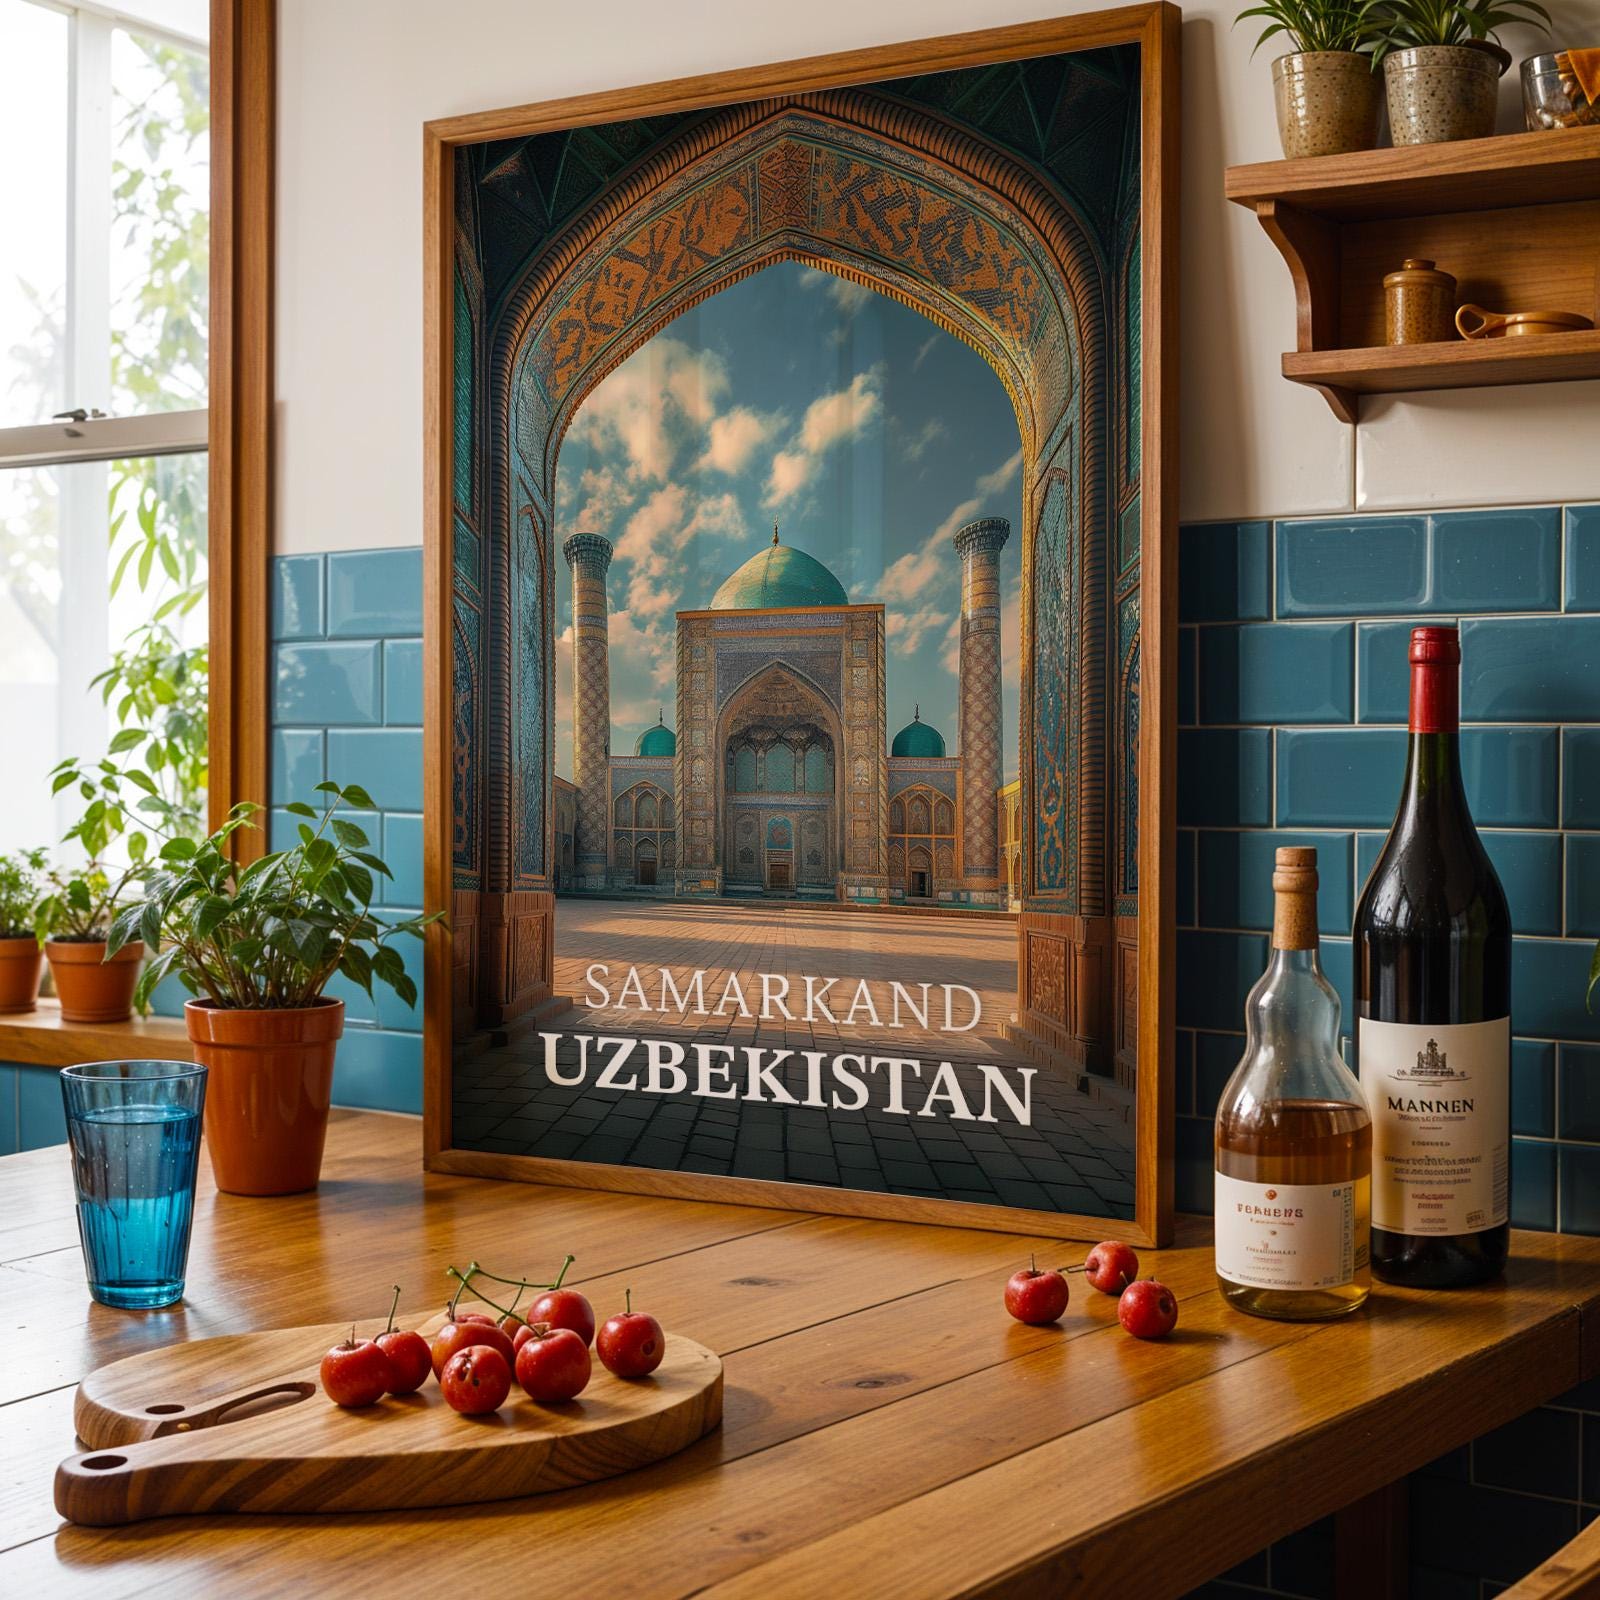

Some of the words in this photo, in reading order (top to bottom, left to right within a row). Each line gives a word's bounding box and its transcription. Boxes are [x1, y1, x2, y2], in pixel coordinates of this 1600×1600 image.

[585, 963, 982, 1032] SAMARKAND
[538, 1032, 1038, 1126] UZBEKISTAN
[1387, 1096, 1475, 1113] MANNEN
